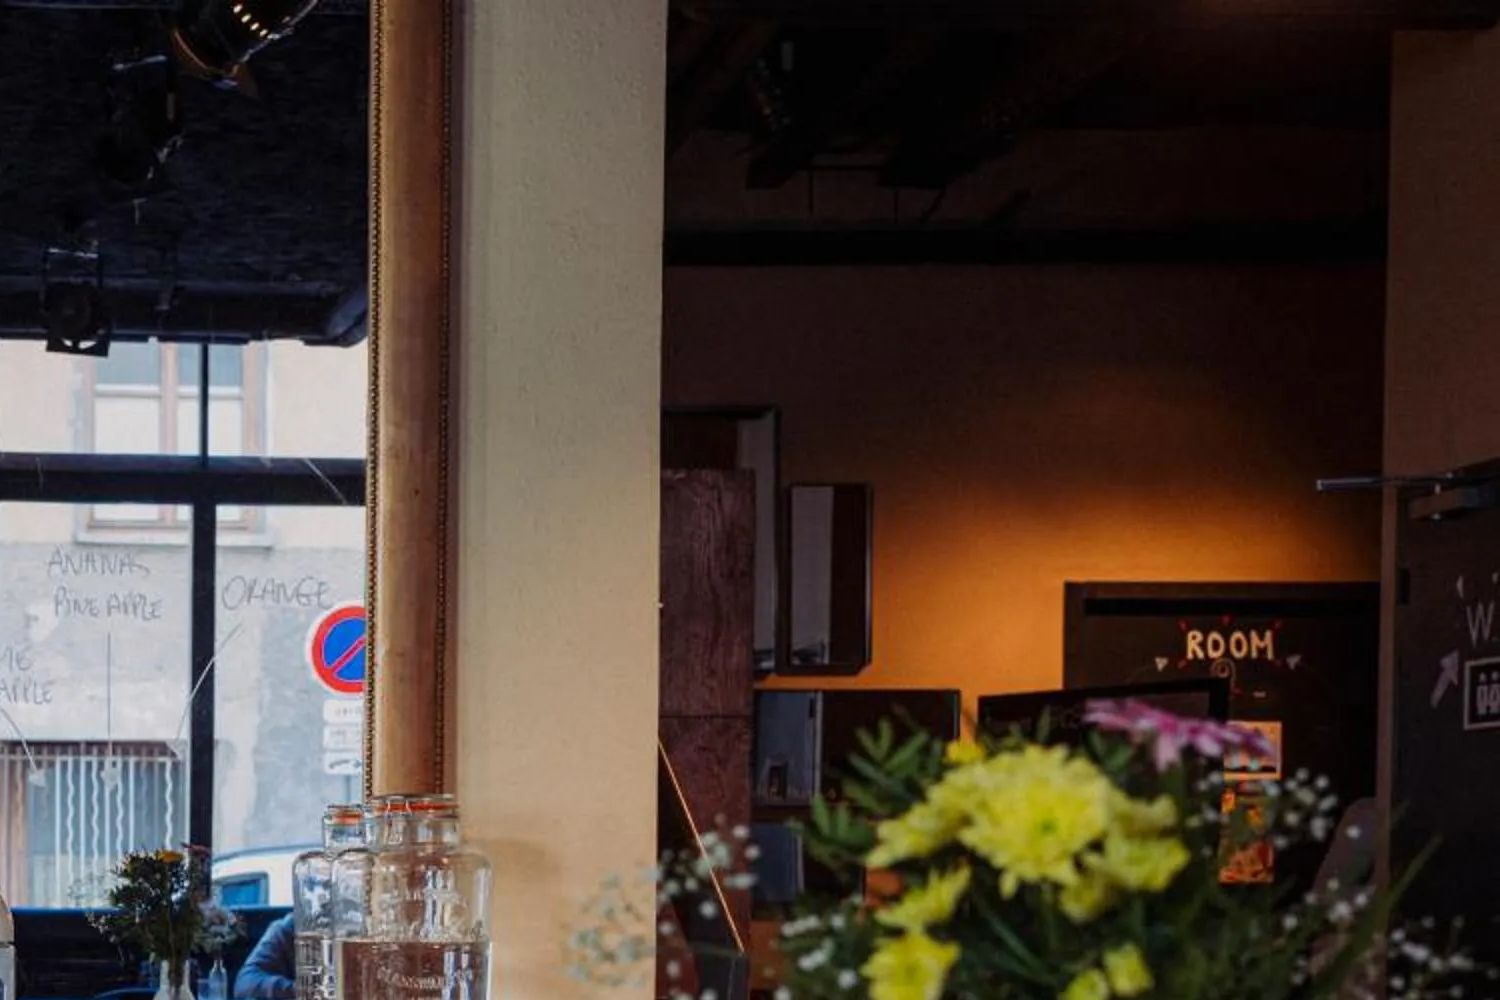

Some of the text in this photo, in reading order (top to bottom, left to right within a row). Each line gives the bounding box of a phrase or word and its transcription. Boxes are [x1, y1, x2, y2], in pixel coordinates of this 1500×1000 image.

[47, 544, 151, 577] ANANAS
[221, 575, 333, 611] ORANGE
[1186, 629, 1275, 660] ROOM
